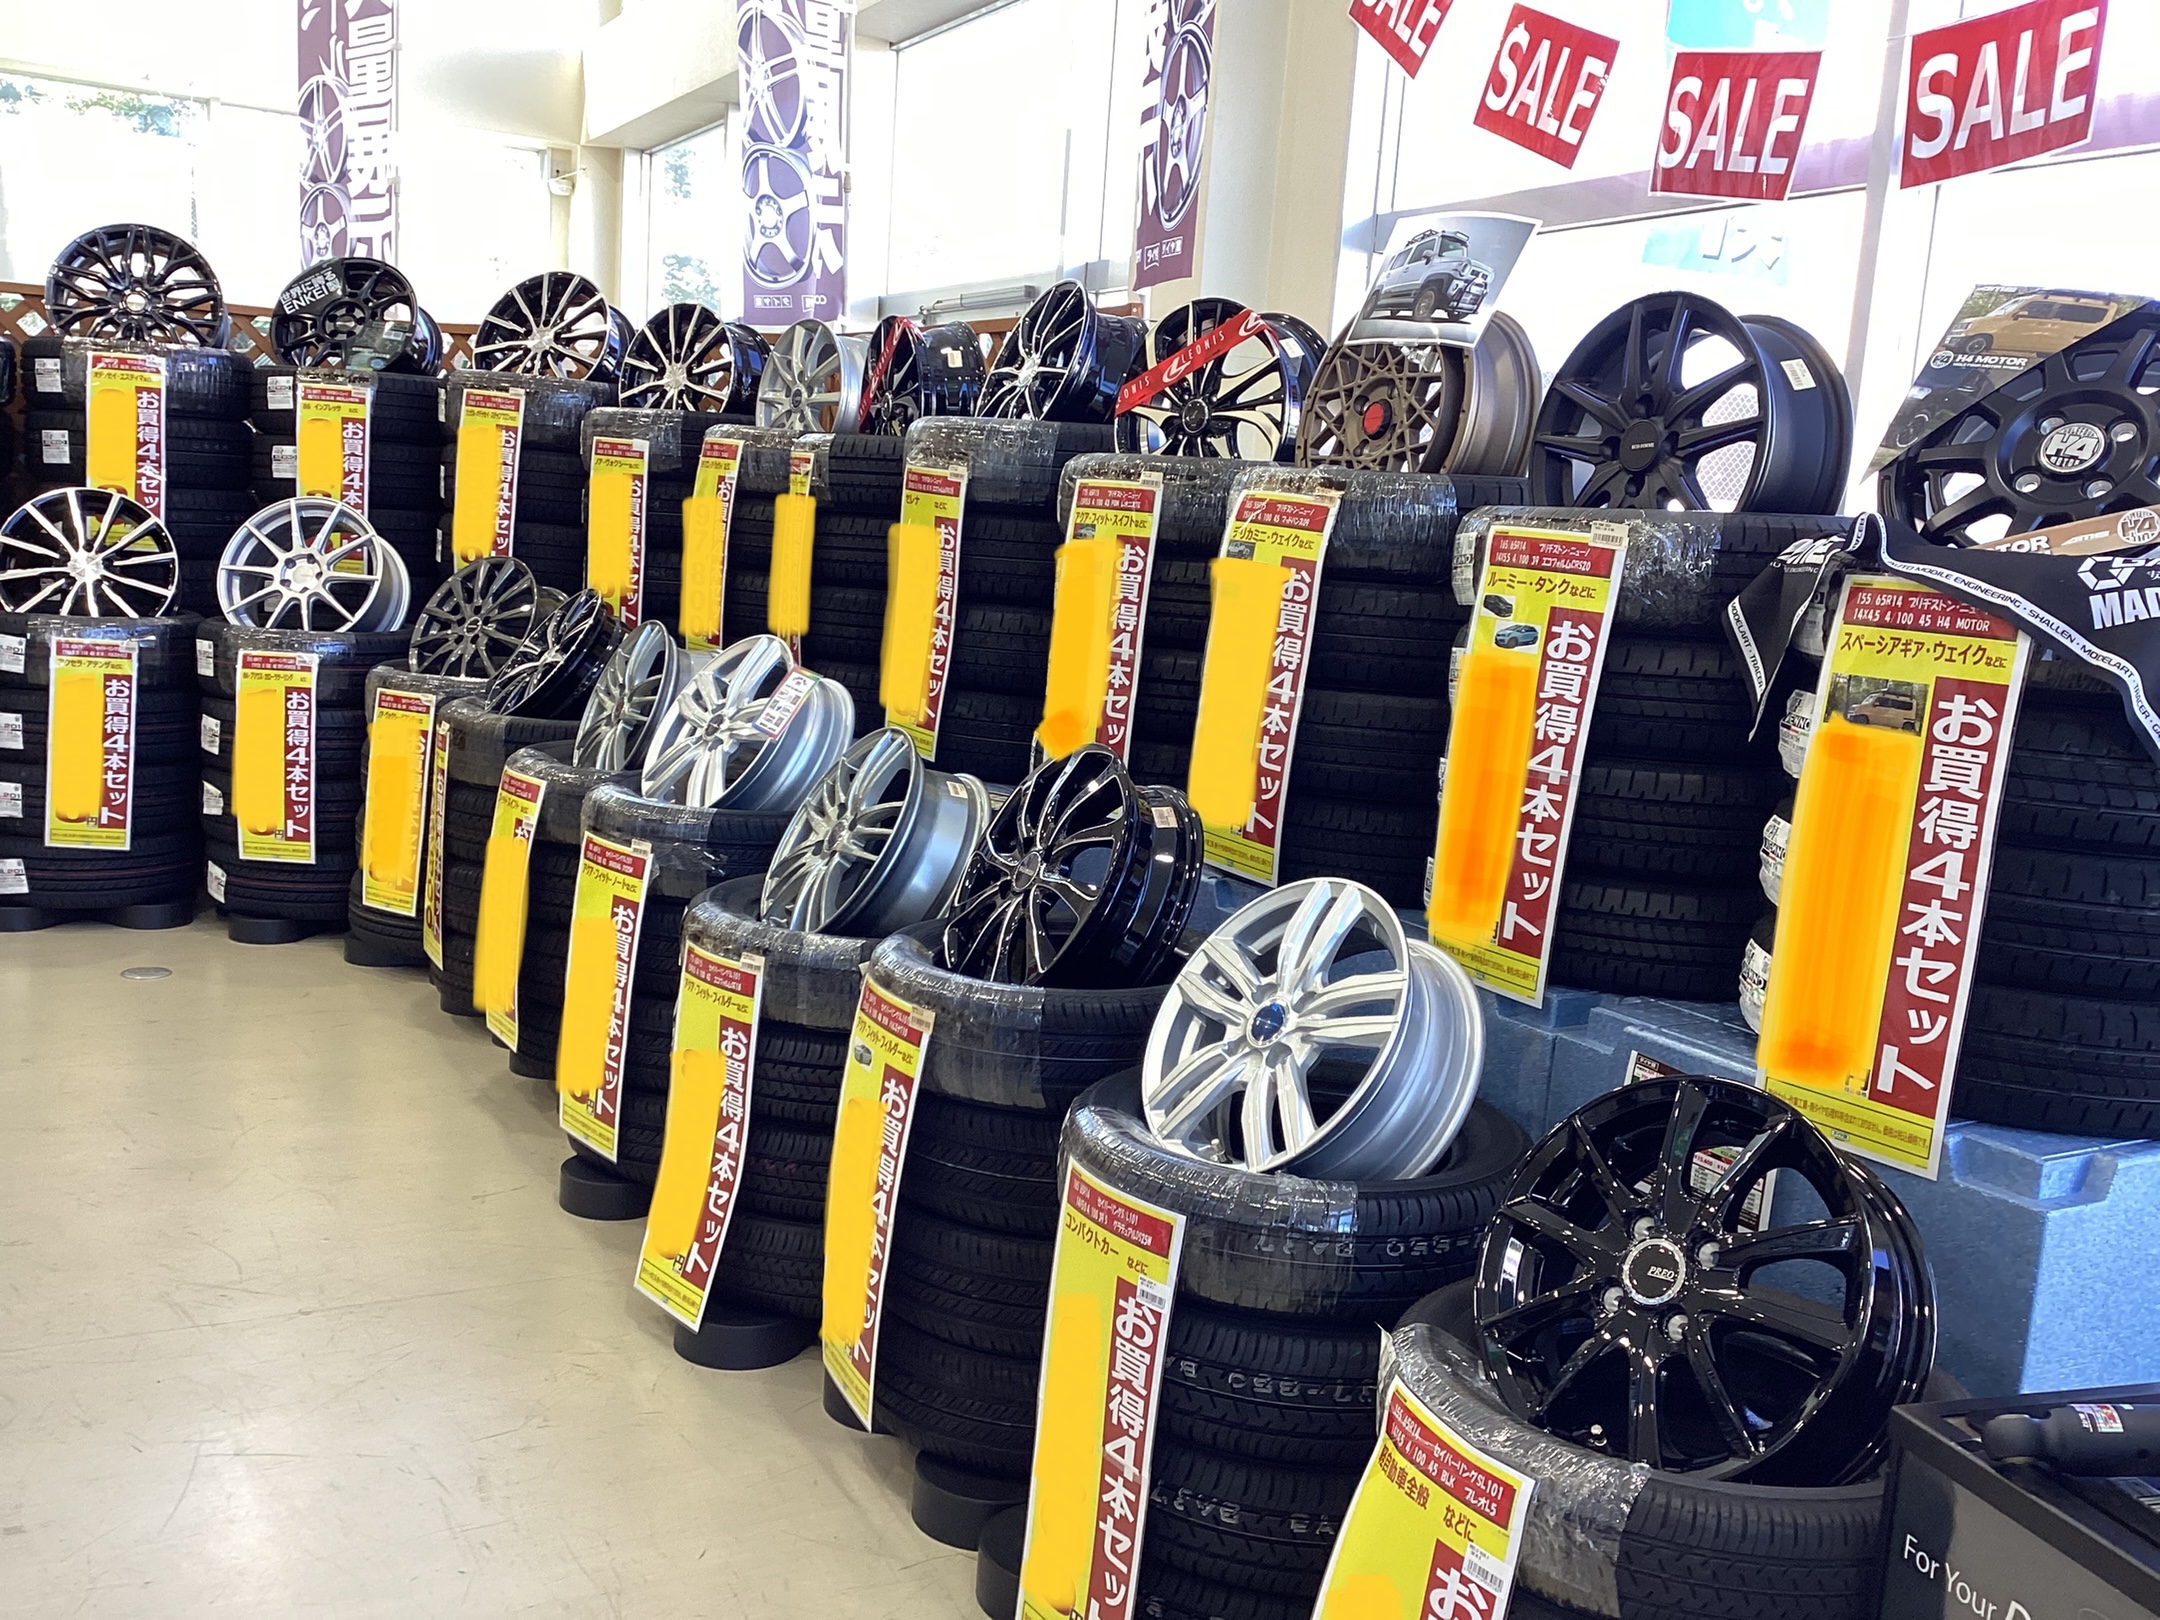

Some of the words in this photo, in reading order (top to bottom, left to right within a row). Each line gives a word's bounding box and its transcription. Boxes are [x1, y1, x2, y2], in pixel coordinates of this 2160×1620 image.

[1485, 21, 1608, 145] SALE
[1658, 76, 1809, 174] SALE
[1911, 7, 2099, 159] SALE
[1181, 331, 1225, 363] LEONIS
[1975, 355, 2028, 367] MOTOR
[342, 422, 364, 514] お買得4本
[2047, 434, 2099, 461] H4
[919, 524, 956, 720] お買得4本セット
[1488, 571, 1597, 599] ルーミー・タンクなどに
[1919, 613, 1932, 627] 45
[1936, 615, 1951, 629] H4
[1956, 616, 1990, 632] MOTOR
[1750, 654, 1764, 688] TRACER
[1840, 632, 2008, 669] スペーシアギア・ウェイクなどに
[1888, 559, 1913, 573] AUTO
[1914, 565, 1952, 581] MOBILE
[1953, 573, 2022, 609] ENGINEERING
[2027, 608, 2077, 644] SHALLEN
[2080, 644, 2135, 679] MODELART
[2133, 682, 2151, 719] TRACER
[1245, 567, 1313, 834] お買得4本セット
[100, 679, 131, 826] お買得4本セット
[285, 692, 310, 838] お買得4本セット
[1502, 620, 1596, 940] お買得4本セット
[1877, 693, 1999, 1095] お買得4本セット
[686, 1026, 748, 1274] お買得4本セット
[673, 1253, 685, 1271] 円
[1066, 1212, 1119, 1255] コンパクトカー
[1127, 1256, 1148, 1276] などに
[1648, 1264, 1676, 1279] PREO
[1090, 1297, 1156, 1620] お買得4本セッ
[1378, 1444, 1430, 1510] 軽自動車全般
[1443, 1504, 1477, 1543] などに
[1428, 1460, 1438, 1476] 45
[1441, 1470, 1456, 1488] BLK
[1464, 1487, 1498, 1517] プレオL5
[1904, 1533, 1940, 1579] For
[1945, 1562, 1998, 1620] Your
